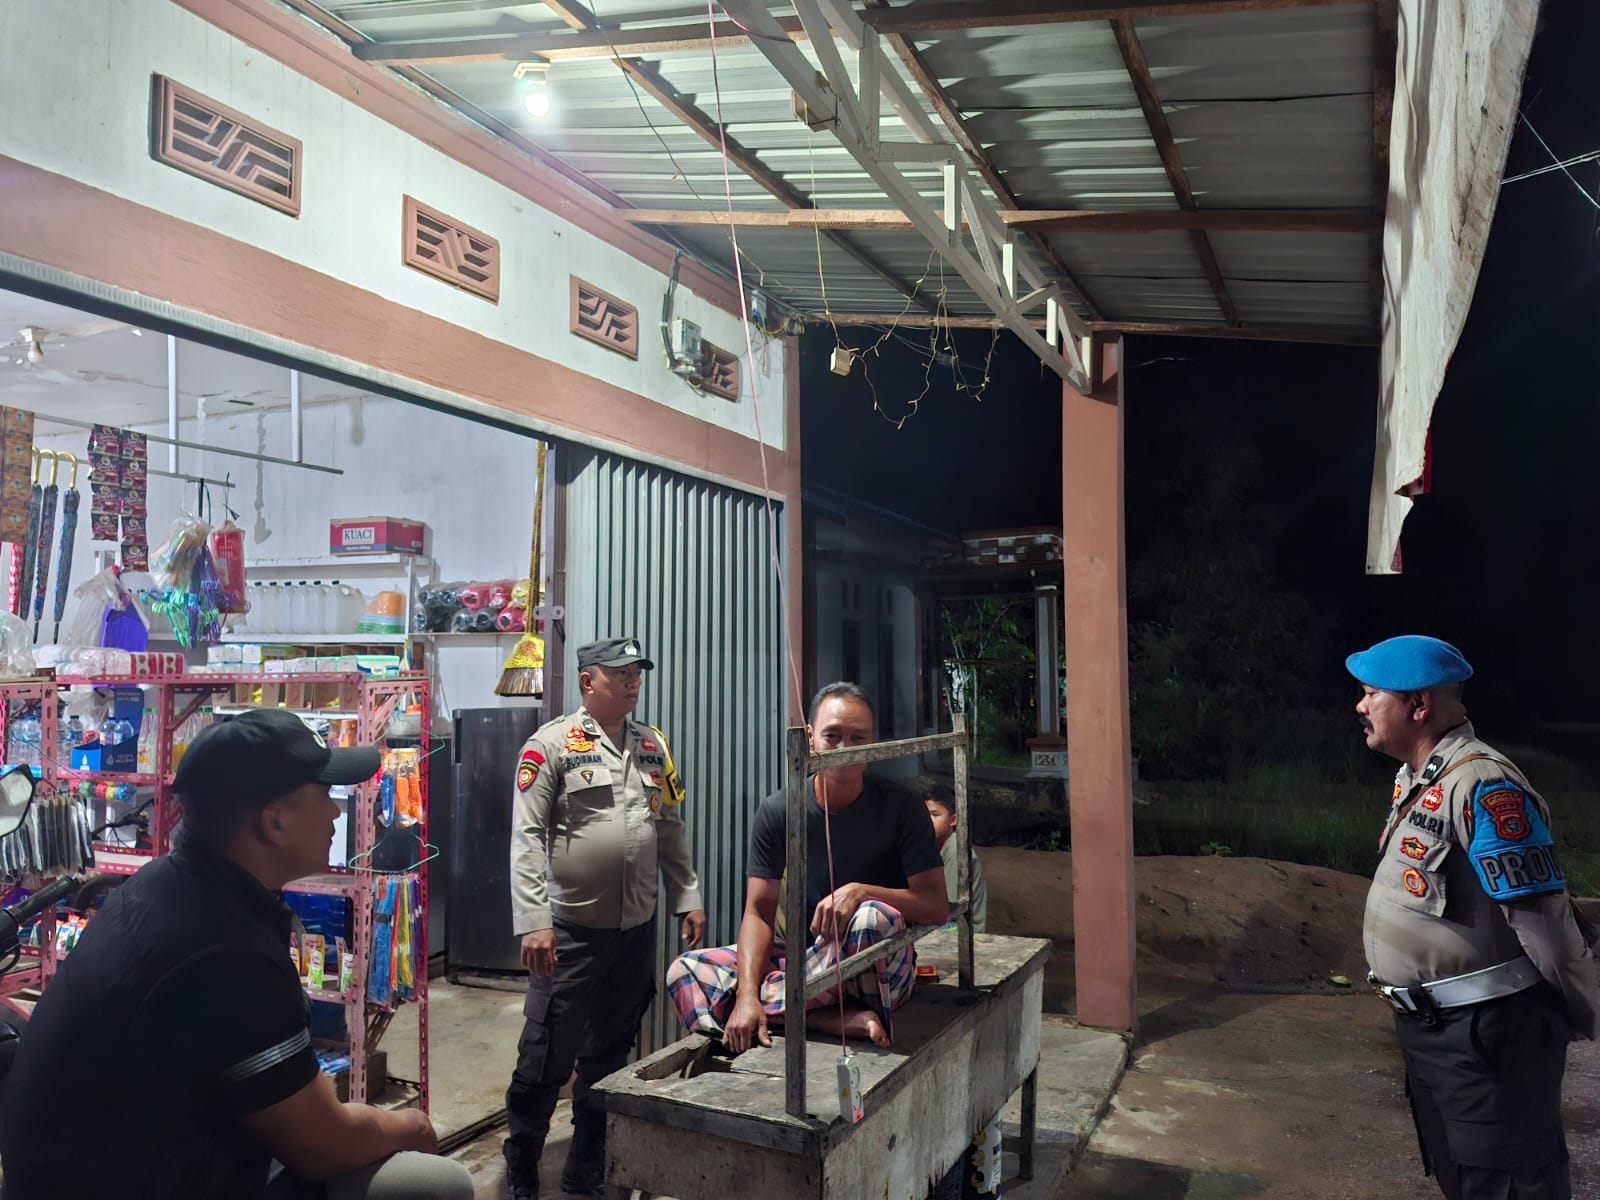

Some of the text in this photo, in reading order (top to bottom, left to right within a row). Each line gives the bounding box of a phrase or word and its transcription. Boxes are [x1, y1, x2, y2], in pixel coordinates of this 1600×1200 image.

[344, 528, 373, 541] KUACI
[565, 753, 603, 768] SUDIRMAN
[1408, 810, 1445, 835] POLRI
